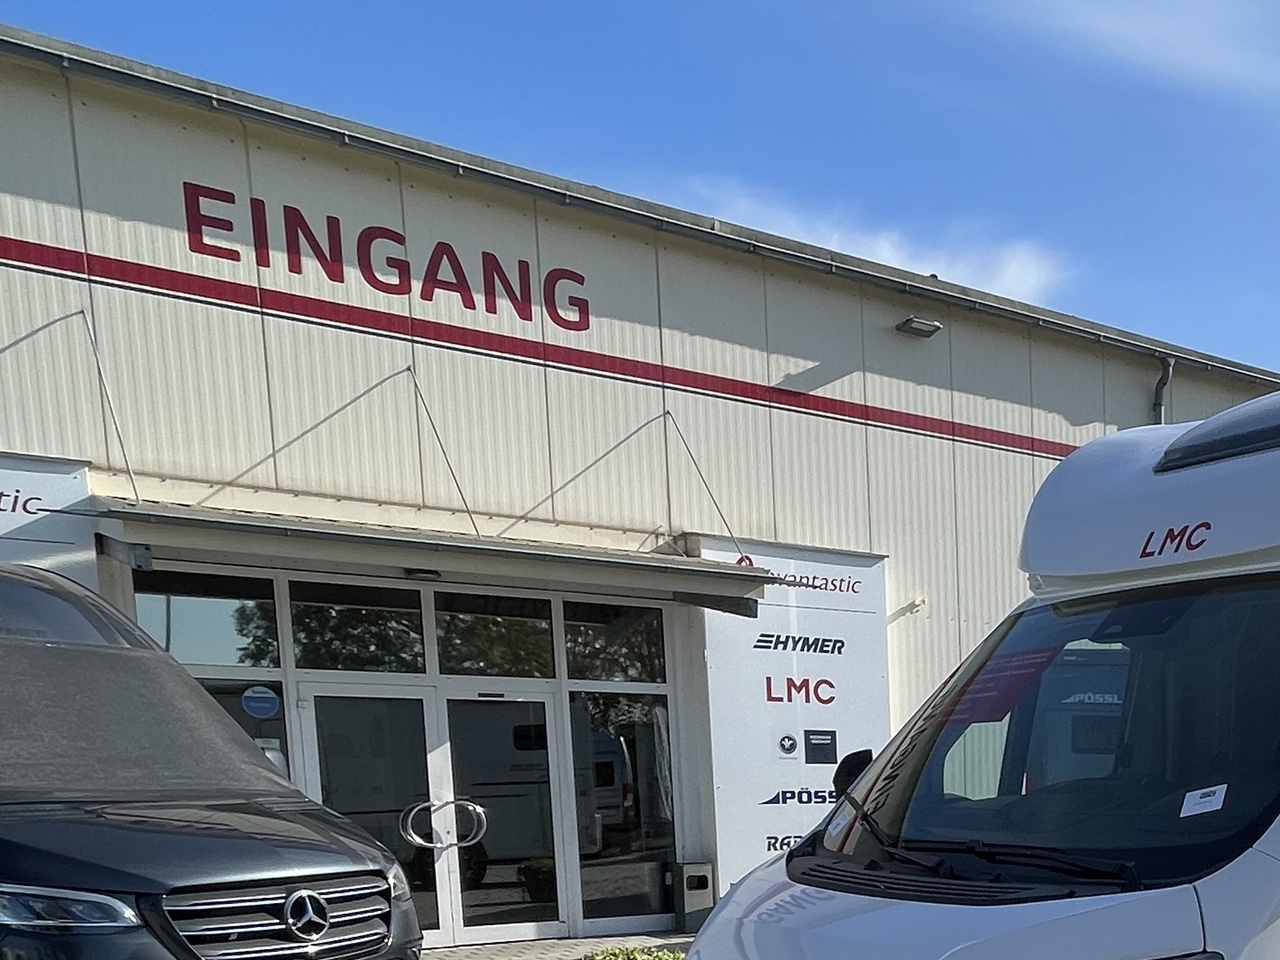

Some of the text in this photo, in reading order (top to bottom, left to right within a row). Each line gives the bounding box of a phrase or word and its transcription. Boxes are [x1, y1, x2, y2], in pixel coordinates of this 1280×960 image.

[183, 181, 590, 332] EINGANG
[1139, 521, 1212, 559] LMC
[773, 634, 845, 655] HYMER
[766, 676, 836, 705] LMC
[781, 787, 838, 805] PÖSS
